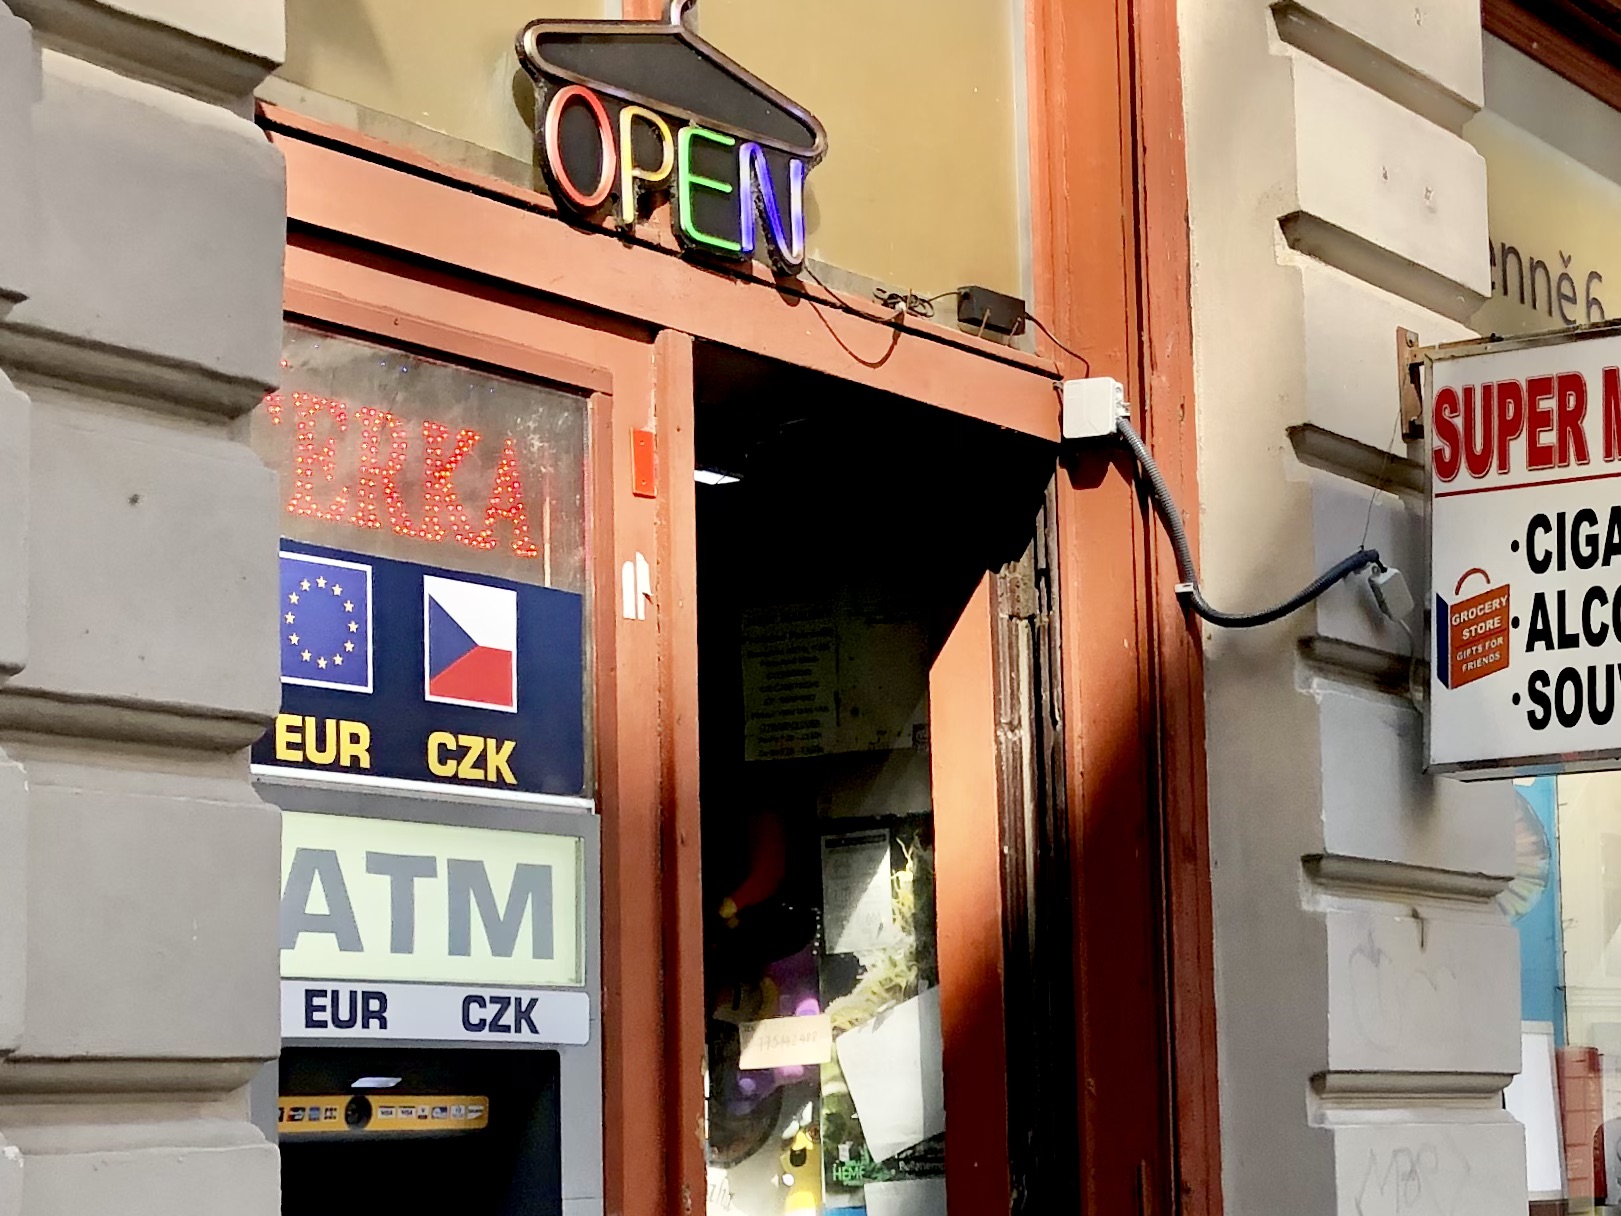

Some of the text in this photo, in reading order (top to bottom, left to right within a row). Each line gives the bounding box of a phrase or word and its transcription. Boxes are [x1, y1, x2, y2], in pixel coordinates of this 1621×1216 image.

[544, 84, 805, 266] OPEN
[1433, 371, 1591, 482] SUPER
[265, 392, 539, 558] ERKA
[1451, 594, 1508, 626] GROCERY
[1462, 616, 1502, 640] STORE
[1456, 636, 1504, 661] GIFTS FOR
[1462, 651, 1501, 673] FRIENDS
[275, 713, 518, 785] EUR CZK
[280, 847, 554, 960] ATM
[304, 989, 540, 1035] EUR CZK
